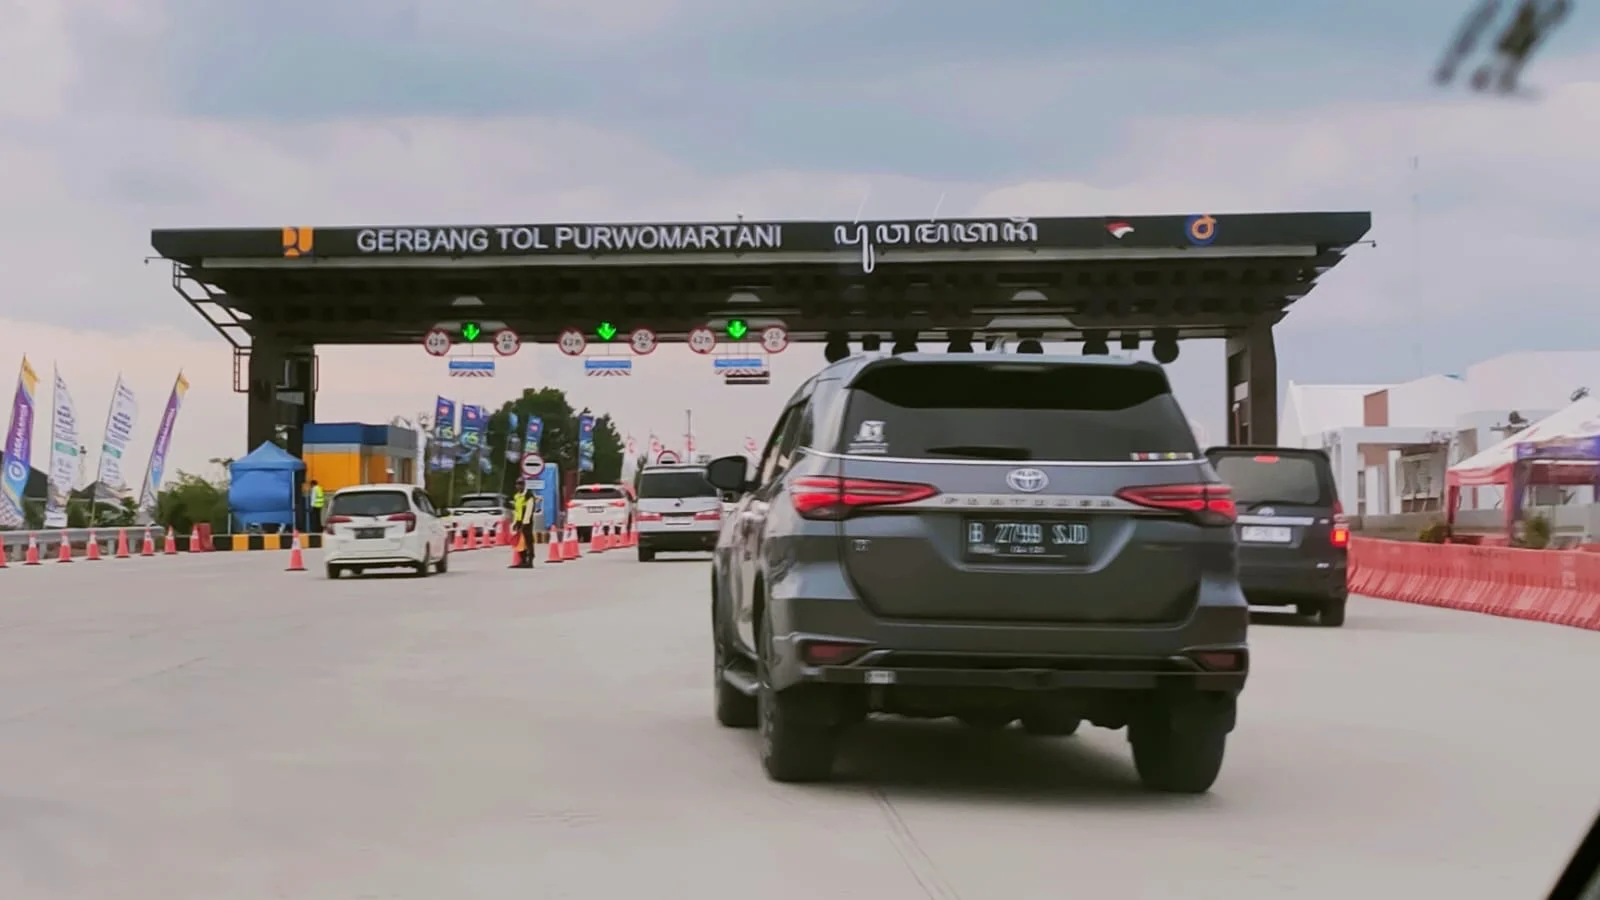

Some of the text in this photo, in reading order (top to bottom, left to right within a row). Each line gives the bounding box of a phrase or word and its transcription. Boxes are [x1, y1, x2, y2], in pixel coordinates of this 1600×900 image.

[357, 225, 782, 252] GERBANG TOL PURWOMARTANI
[968, 522, 984, 543] B
